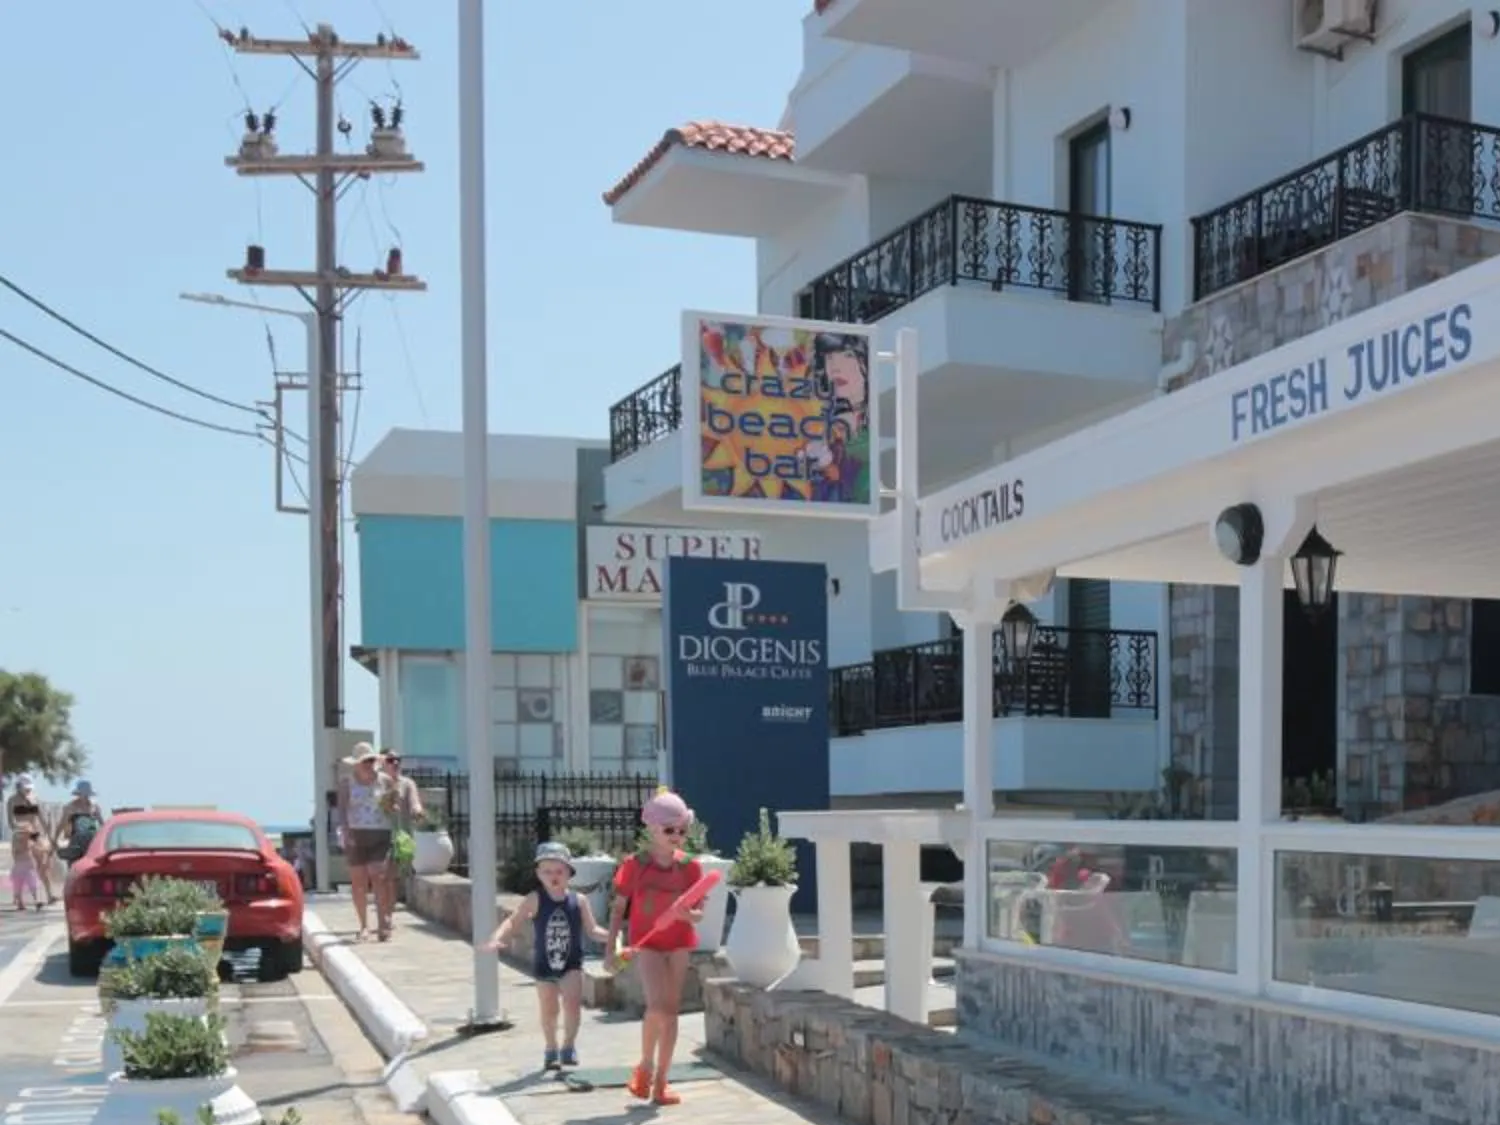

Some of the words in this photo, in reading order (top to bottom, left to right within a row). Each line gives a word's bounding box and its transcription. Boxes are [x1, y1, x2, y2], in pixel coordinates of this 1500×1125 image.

[719, 372, 836, 401] crazy
[1231, 356, 1329, 442] FRESH
[1343, 302, 1473, 401] JUICES
[705, 403, 851, 441] beach
[743, 447, 824, 482] bar
[940, 478, 1025, 543] COCKTAILS
[614, 532, 763, 561] SUPER
[678, 634, 822, 665] DIOGENIS
